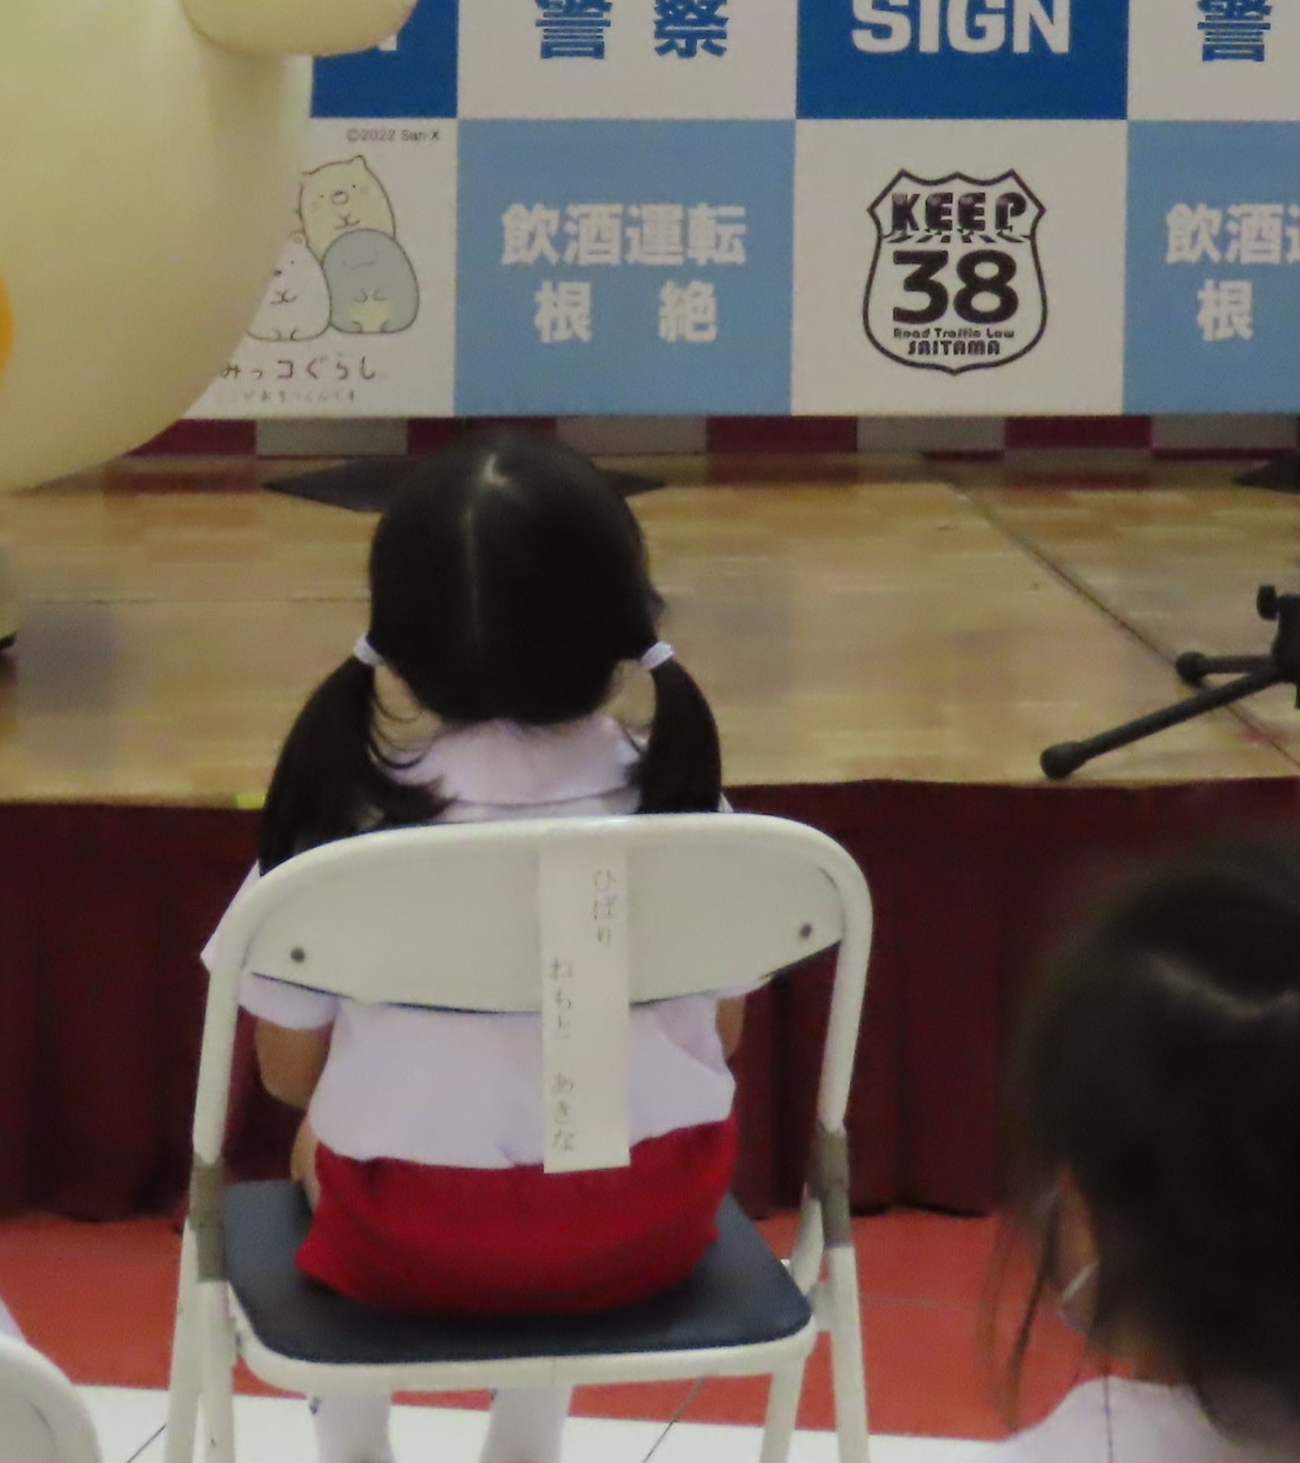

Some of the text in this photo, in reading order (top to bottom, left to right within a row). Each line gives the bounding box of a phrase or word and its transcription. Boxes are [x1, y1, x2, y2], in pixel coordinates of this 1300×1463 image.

[891, 191, 1028, 232] KEEP
[501, 202, 746, 268] 飲酒運転
[892, 249, 1019, 325] 38
[220, 354, 376, 381] みっコぐらし
[907, 339, 1000, 356] SAITAMA
